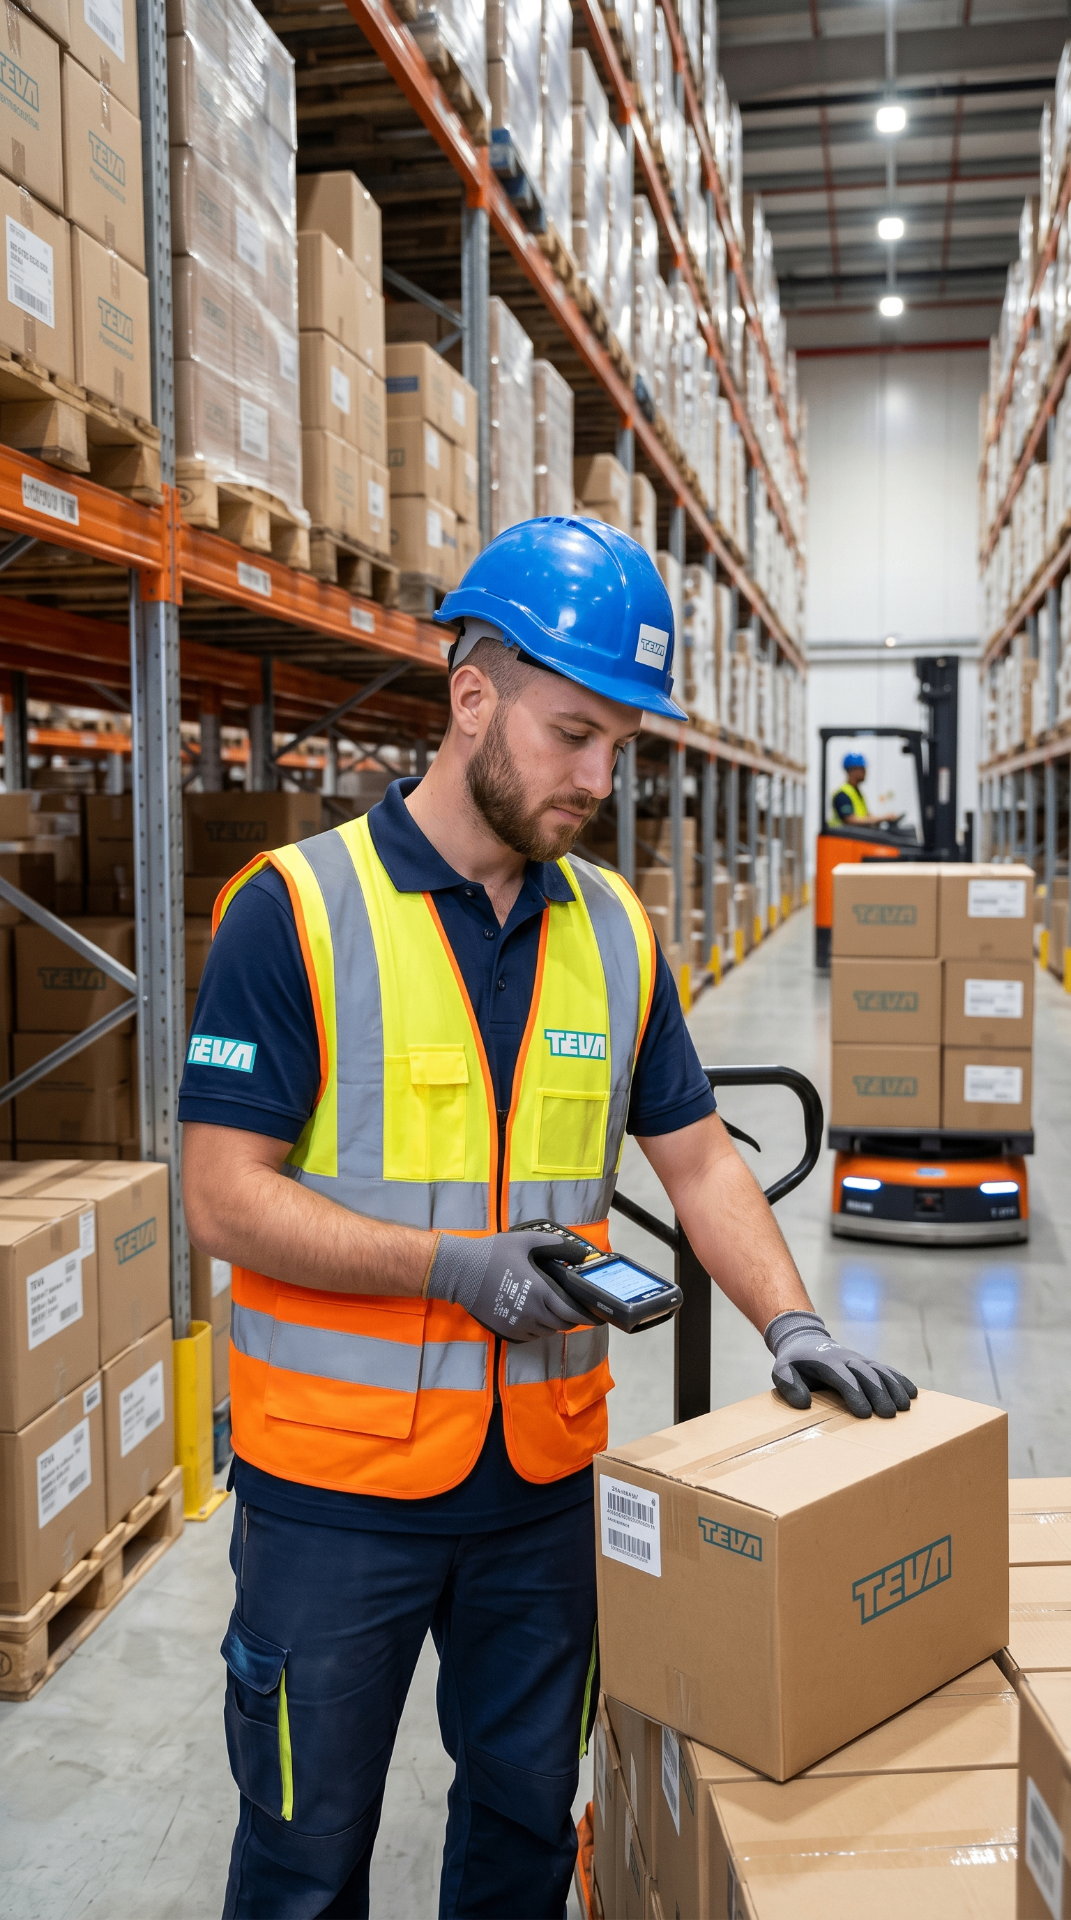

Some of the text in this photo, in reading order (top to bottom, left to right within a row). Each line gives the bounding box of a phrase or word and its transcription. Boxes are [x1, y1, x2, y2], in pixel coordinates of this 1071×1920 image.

[88, 130, 125, 187] TEVA
[98, 296, 133, 344] TEVA
[641, 638, 665, 657] TEVA
[205, 821, 268, 842] TEVA
[852, 905, 917, 926] TEVA
[38, 966, 107, 990] TEVA
[853, 990, 918, 1012] TEVA
[187, 1034, 257, 1073] TEVA
[544, 1029, 606, 1060] TEVA
[853, 1076, 917, 1097] TEVA
[114, 1216, 156, 1266] TEVA
[30, 1277, 44, 1291] TEVA
[699, 1516, 762, 1562] TEVA
[852, 1534, 951, 1625] TEVA
